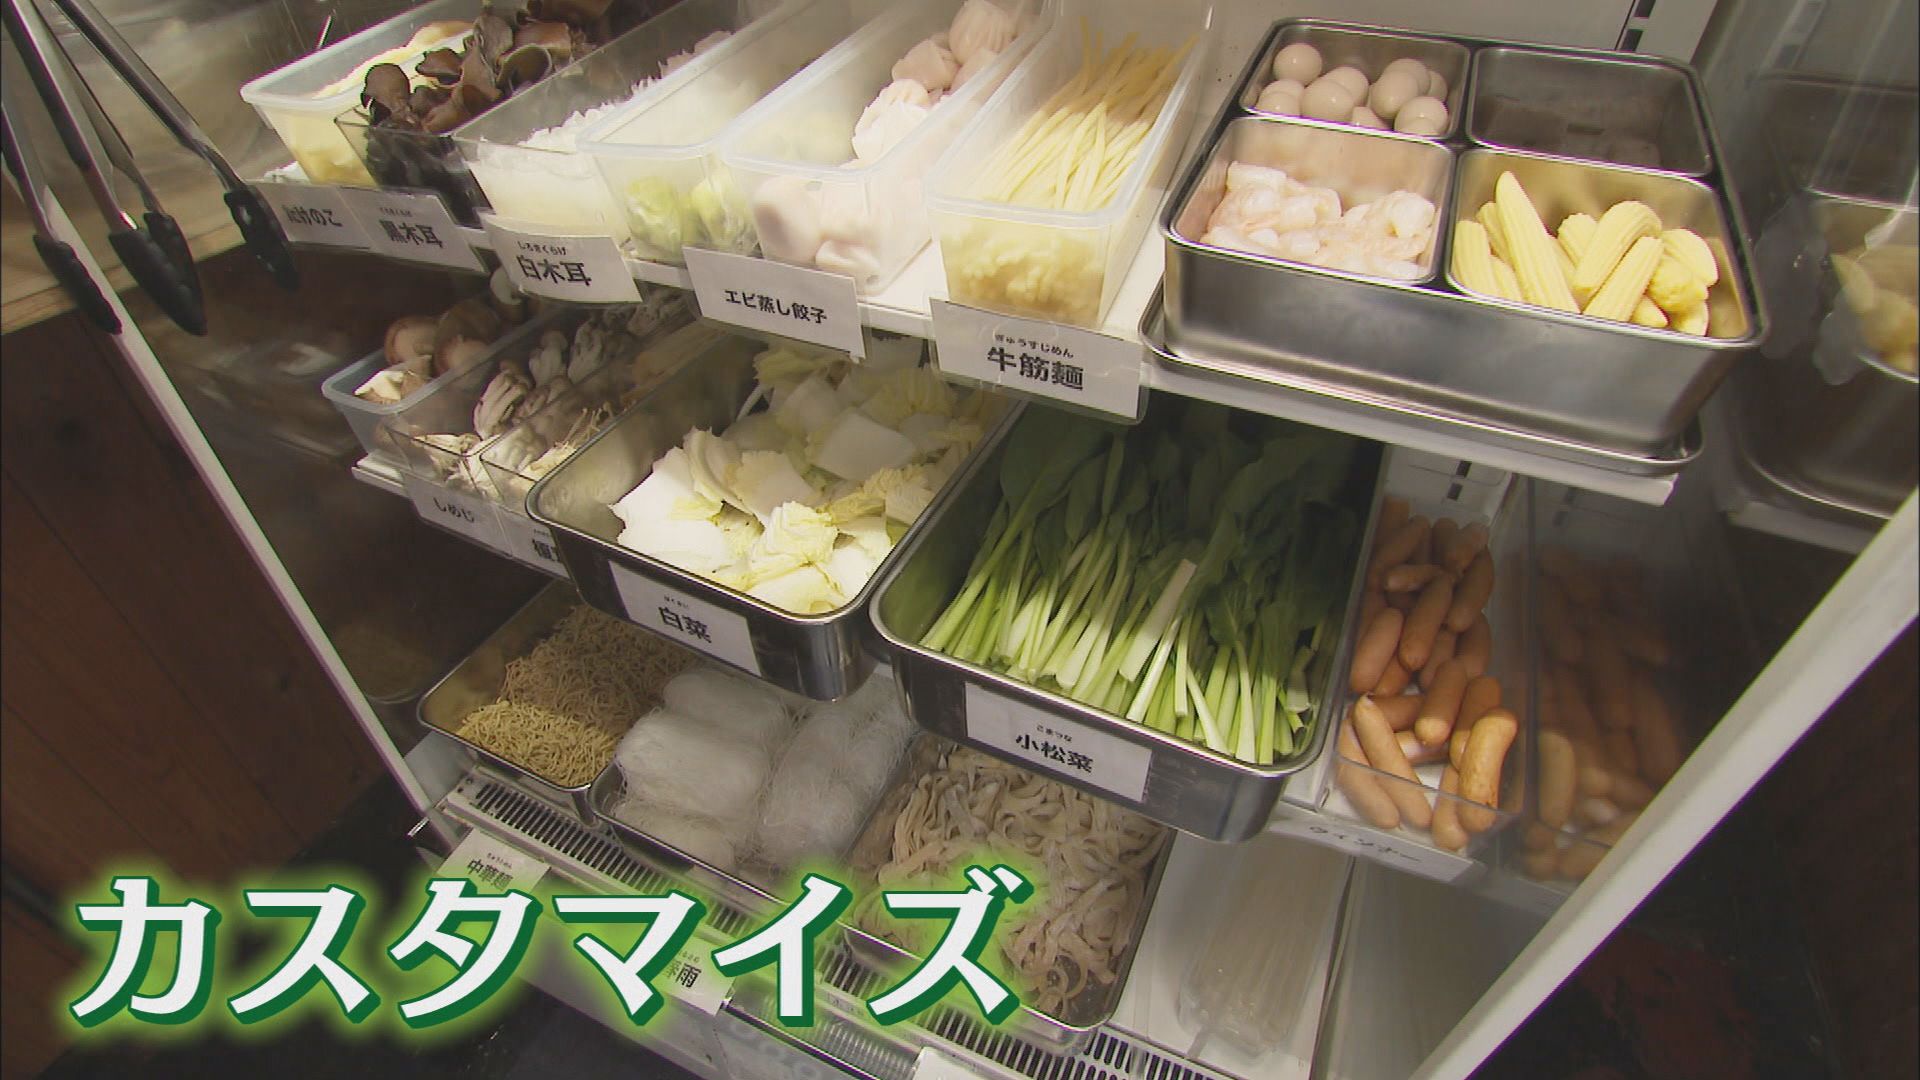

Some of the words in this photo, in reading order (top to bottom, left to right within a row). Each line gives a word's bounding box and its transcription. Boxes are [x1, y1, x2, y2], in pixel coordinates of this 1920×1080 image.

[379, 218, 443, 248] 黒木耳
[516, 254, 592, 287] 白木耳
[724, 289, 827, 324] エビ蒸し餃子
[434, 497, 475, 523] しめじ
[658, 606, 712, 643] 白菜
[1016, 734, 1094, 773] 小松菜
